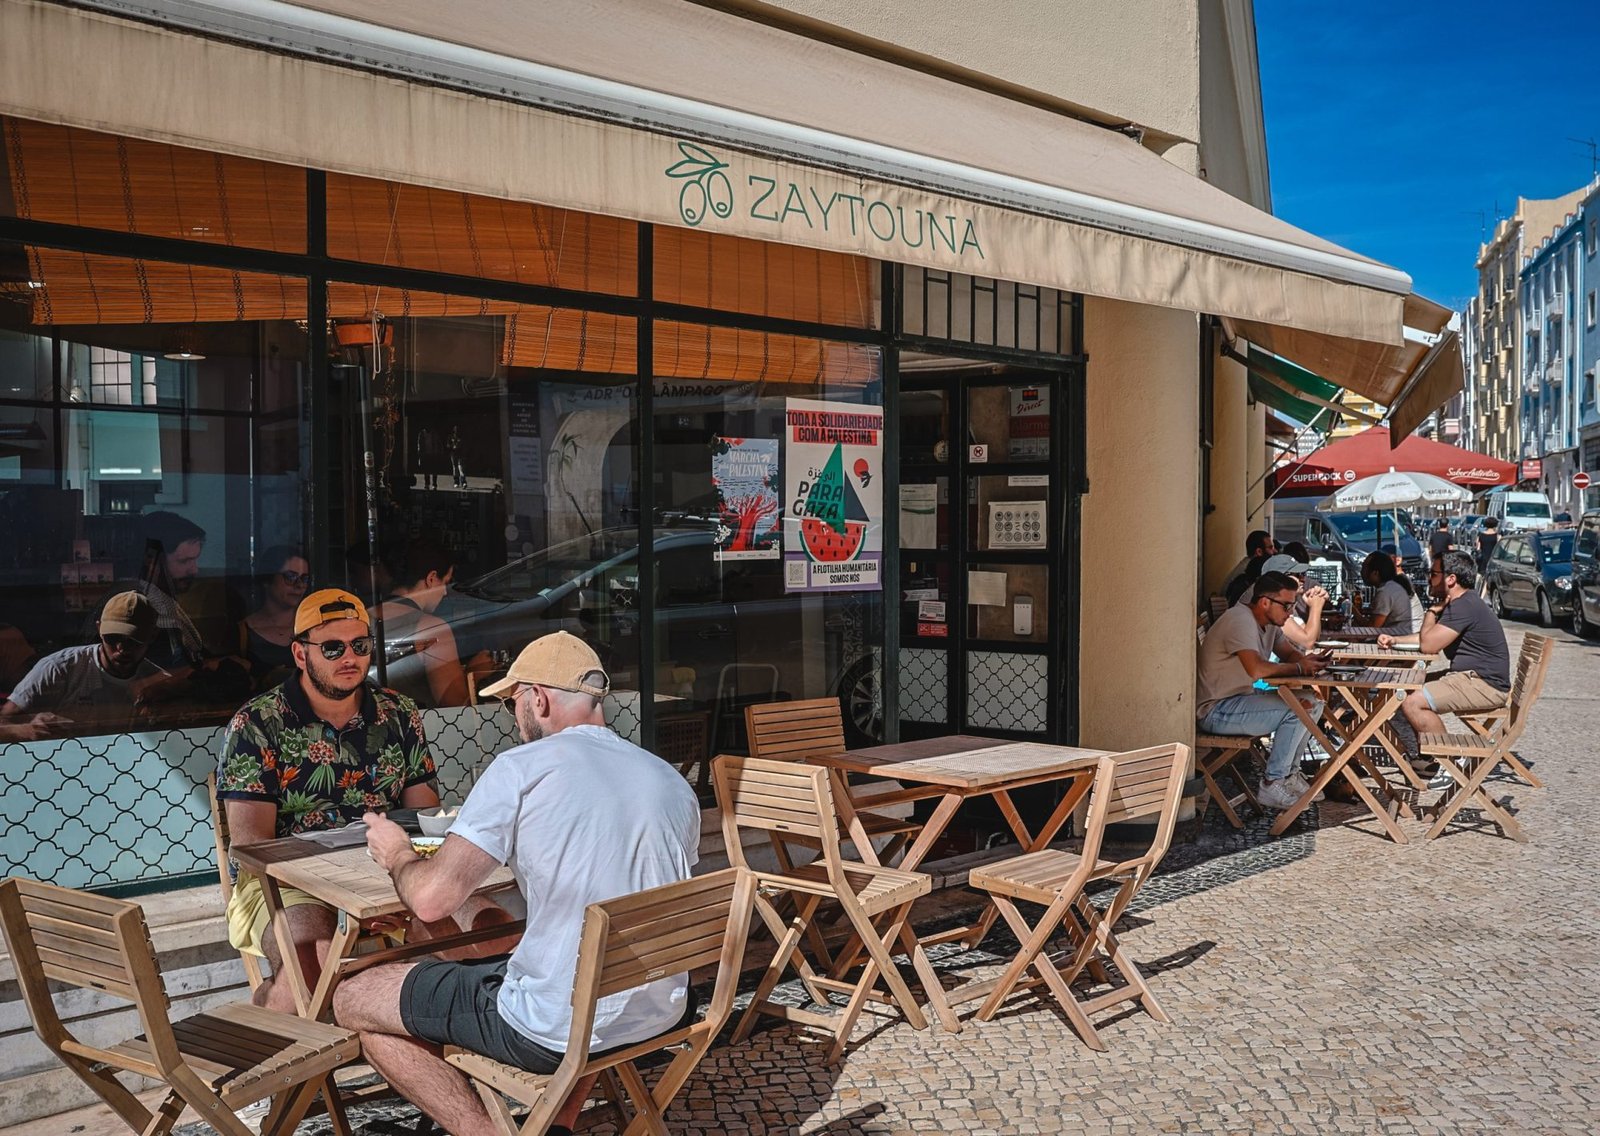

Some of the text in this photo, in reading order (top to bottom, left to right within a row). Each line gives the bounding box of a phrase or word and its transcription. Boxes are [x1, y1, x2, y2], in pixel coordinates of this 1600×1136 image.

[749, 175, 985, 260] ZAYTOUNA
[583, 387, 613, 401] ADR
[787, 411, 883, 431] TODA A SOLIDARIEDADE
[798, 427, 873, 444] COM A PALESTINA
[729, 451, 760, 463] MARCHA
[729, 463, 768, 477] PALESTINA
[1292, 472, 1342, 483] SUPER BOCK
[797, 481, 843, 502] PARA
[792, 499, 839, 519] GAZA
[813, 562, 877, 574] A FLOTILHA HUMANITÁRIA
[829, 575, 850, 584] SOMOS
